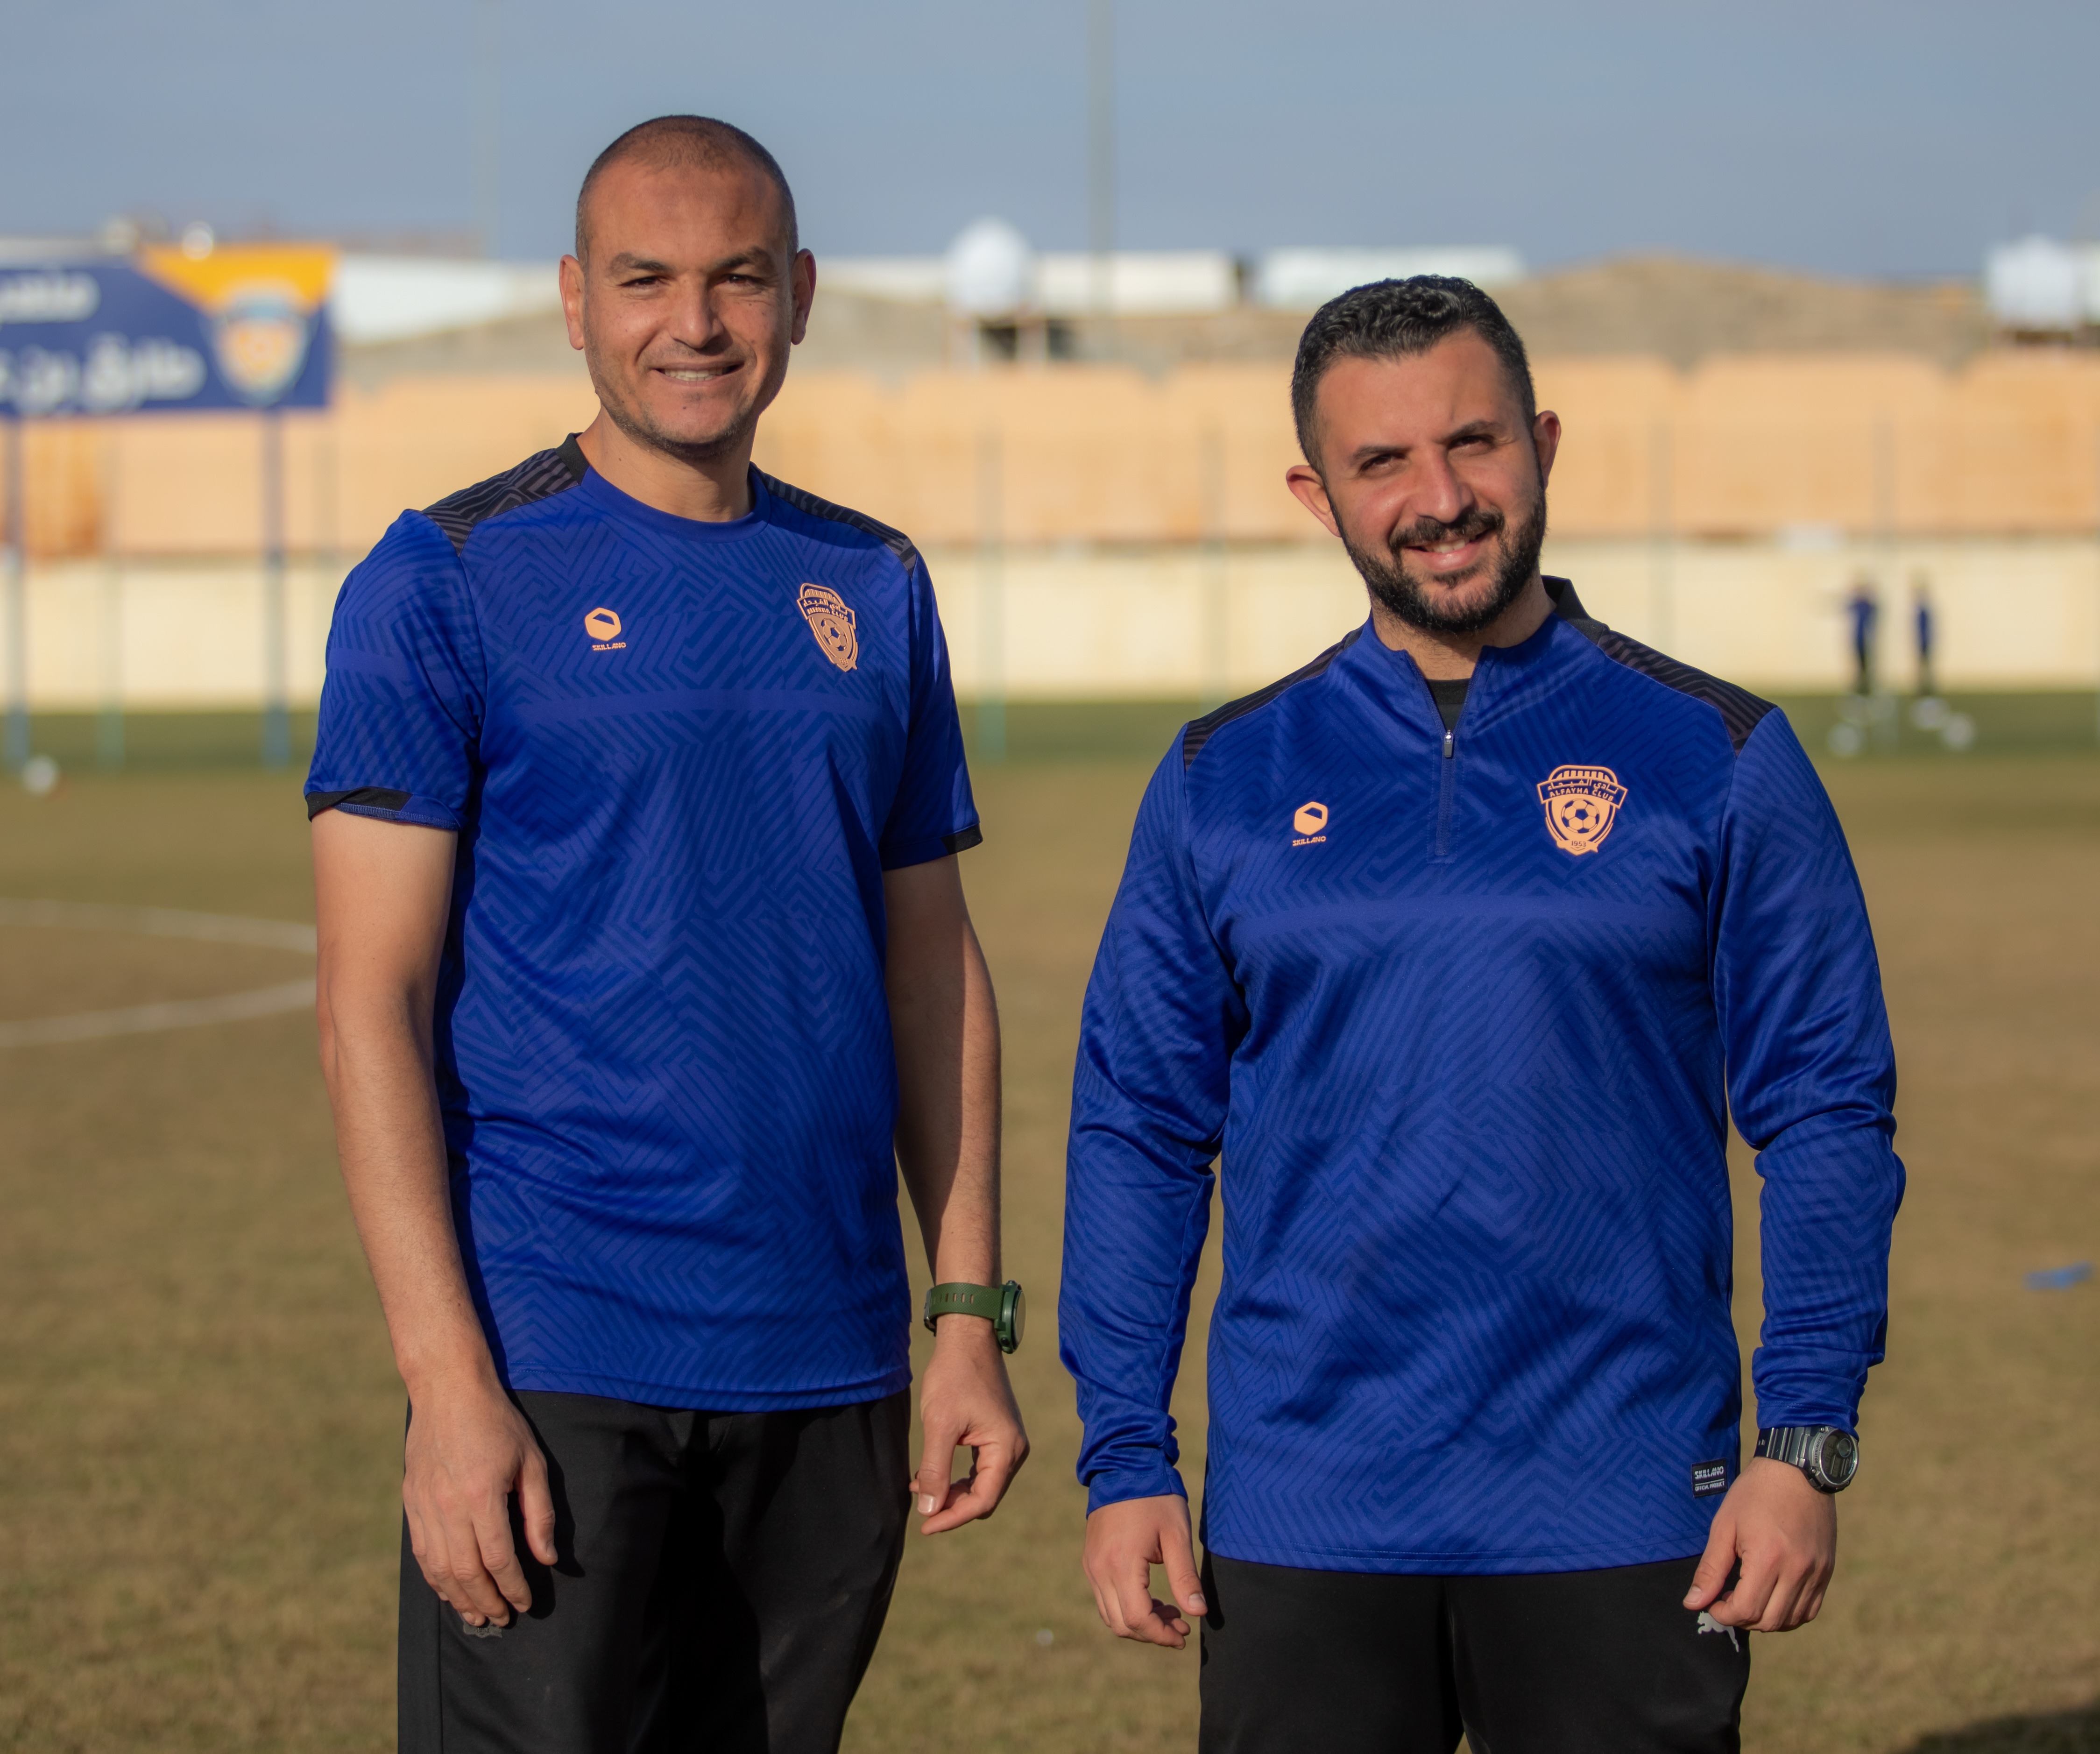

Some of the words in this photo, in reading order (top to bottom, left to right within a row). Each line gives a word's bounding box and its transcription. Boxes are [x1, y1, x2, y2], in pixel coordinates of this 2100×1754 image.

[592, 642, 627, 651] SKILLANO
[1548, 778, 1592, 791] الفيحاء
[1593, 782, 1619, 795] نادي
[1549, 787, 1589, 798] ALFAYHA
[1591, 789, 1614, 802] CLUB
[1292, 835, 1327, 847] SKILLANO
[1814, 1435, 1824, 1464] ILLUMINATOR
[1695, 1465, 1724, 1479] SKILLANO
